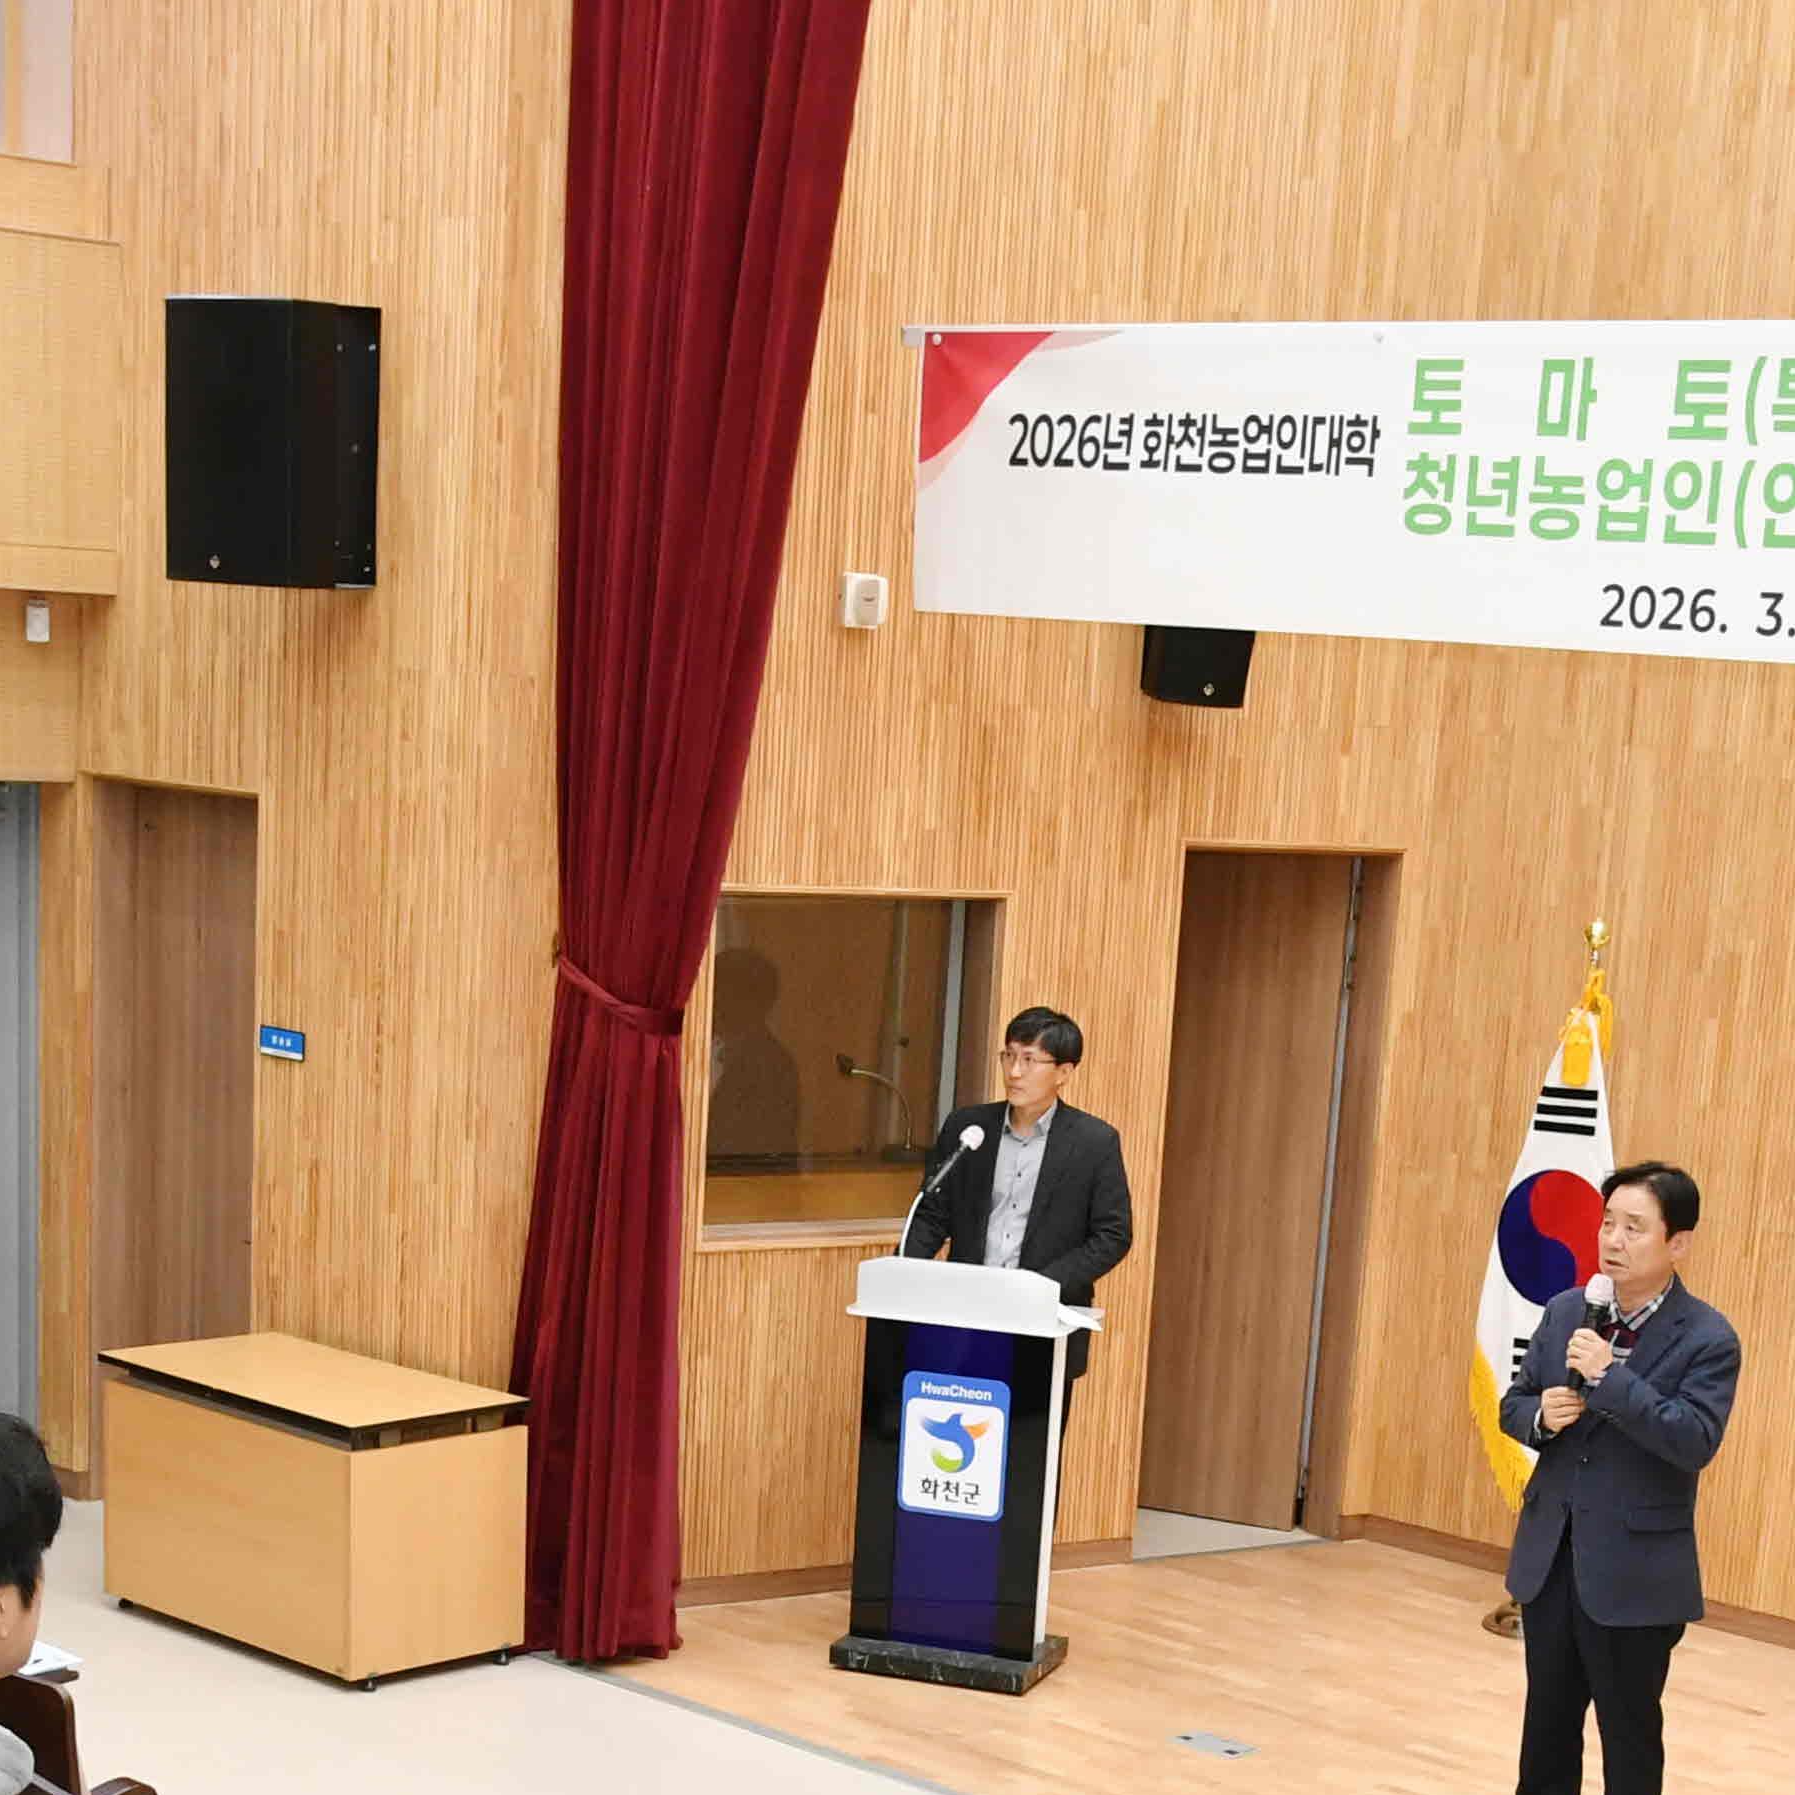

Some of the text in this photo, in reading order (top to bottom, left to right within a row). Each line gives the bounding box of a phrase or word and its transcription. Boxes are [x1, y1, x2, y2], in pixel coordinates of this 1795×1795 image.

[1008, 412, 1381, 478] 2026년 화천농업인대학
[1600, 583, 1727, 634] 2026.
[1755, 591, 1795, 638] 3.
[920, 1381, 993, 1400] HwaCheon
[920, 1477, 981, 1505] 화천군
